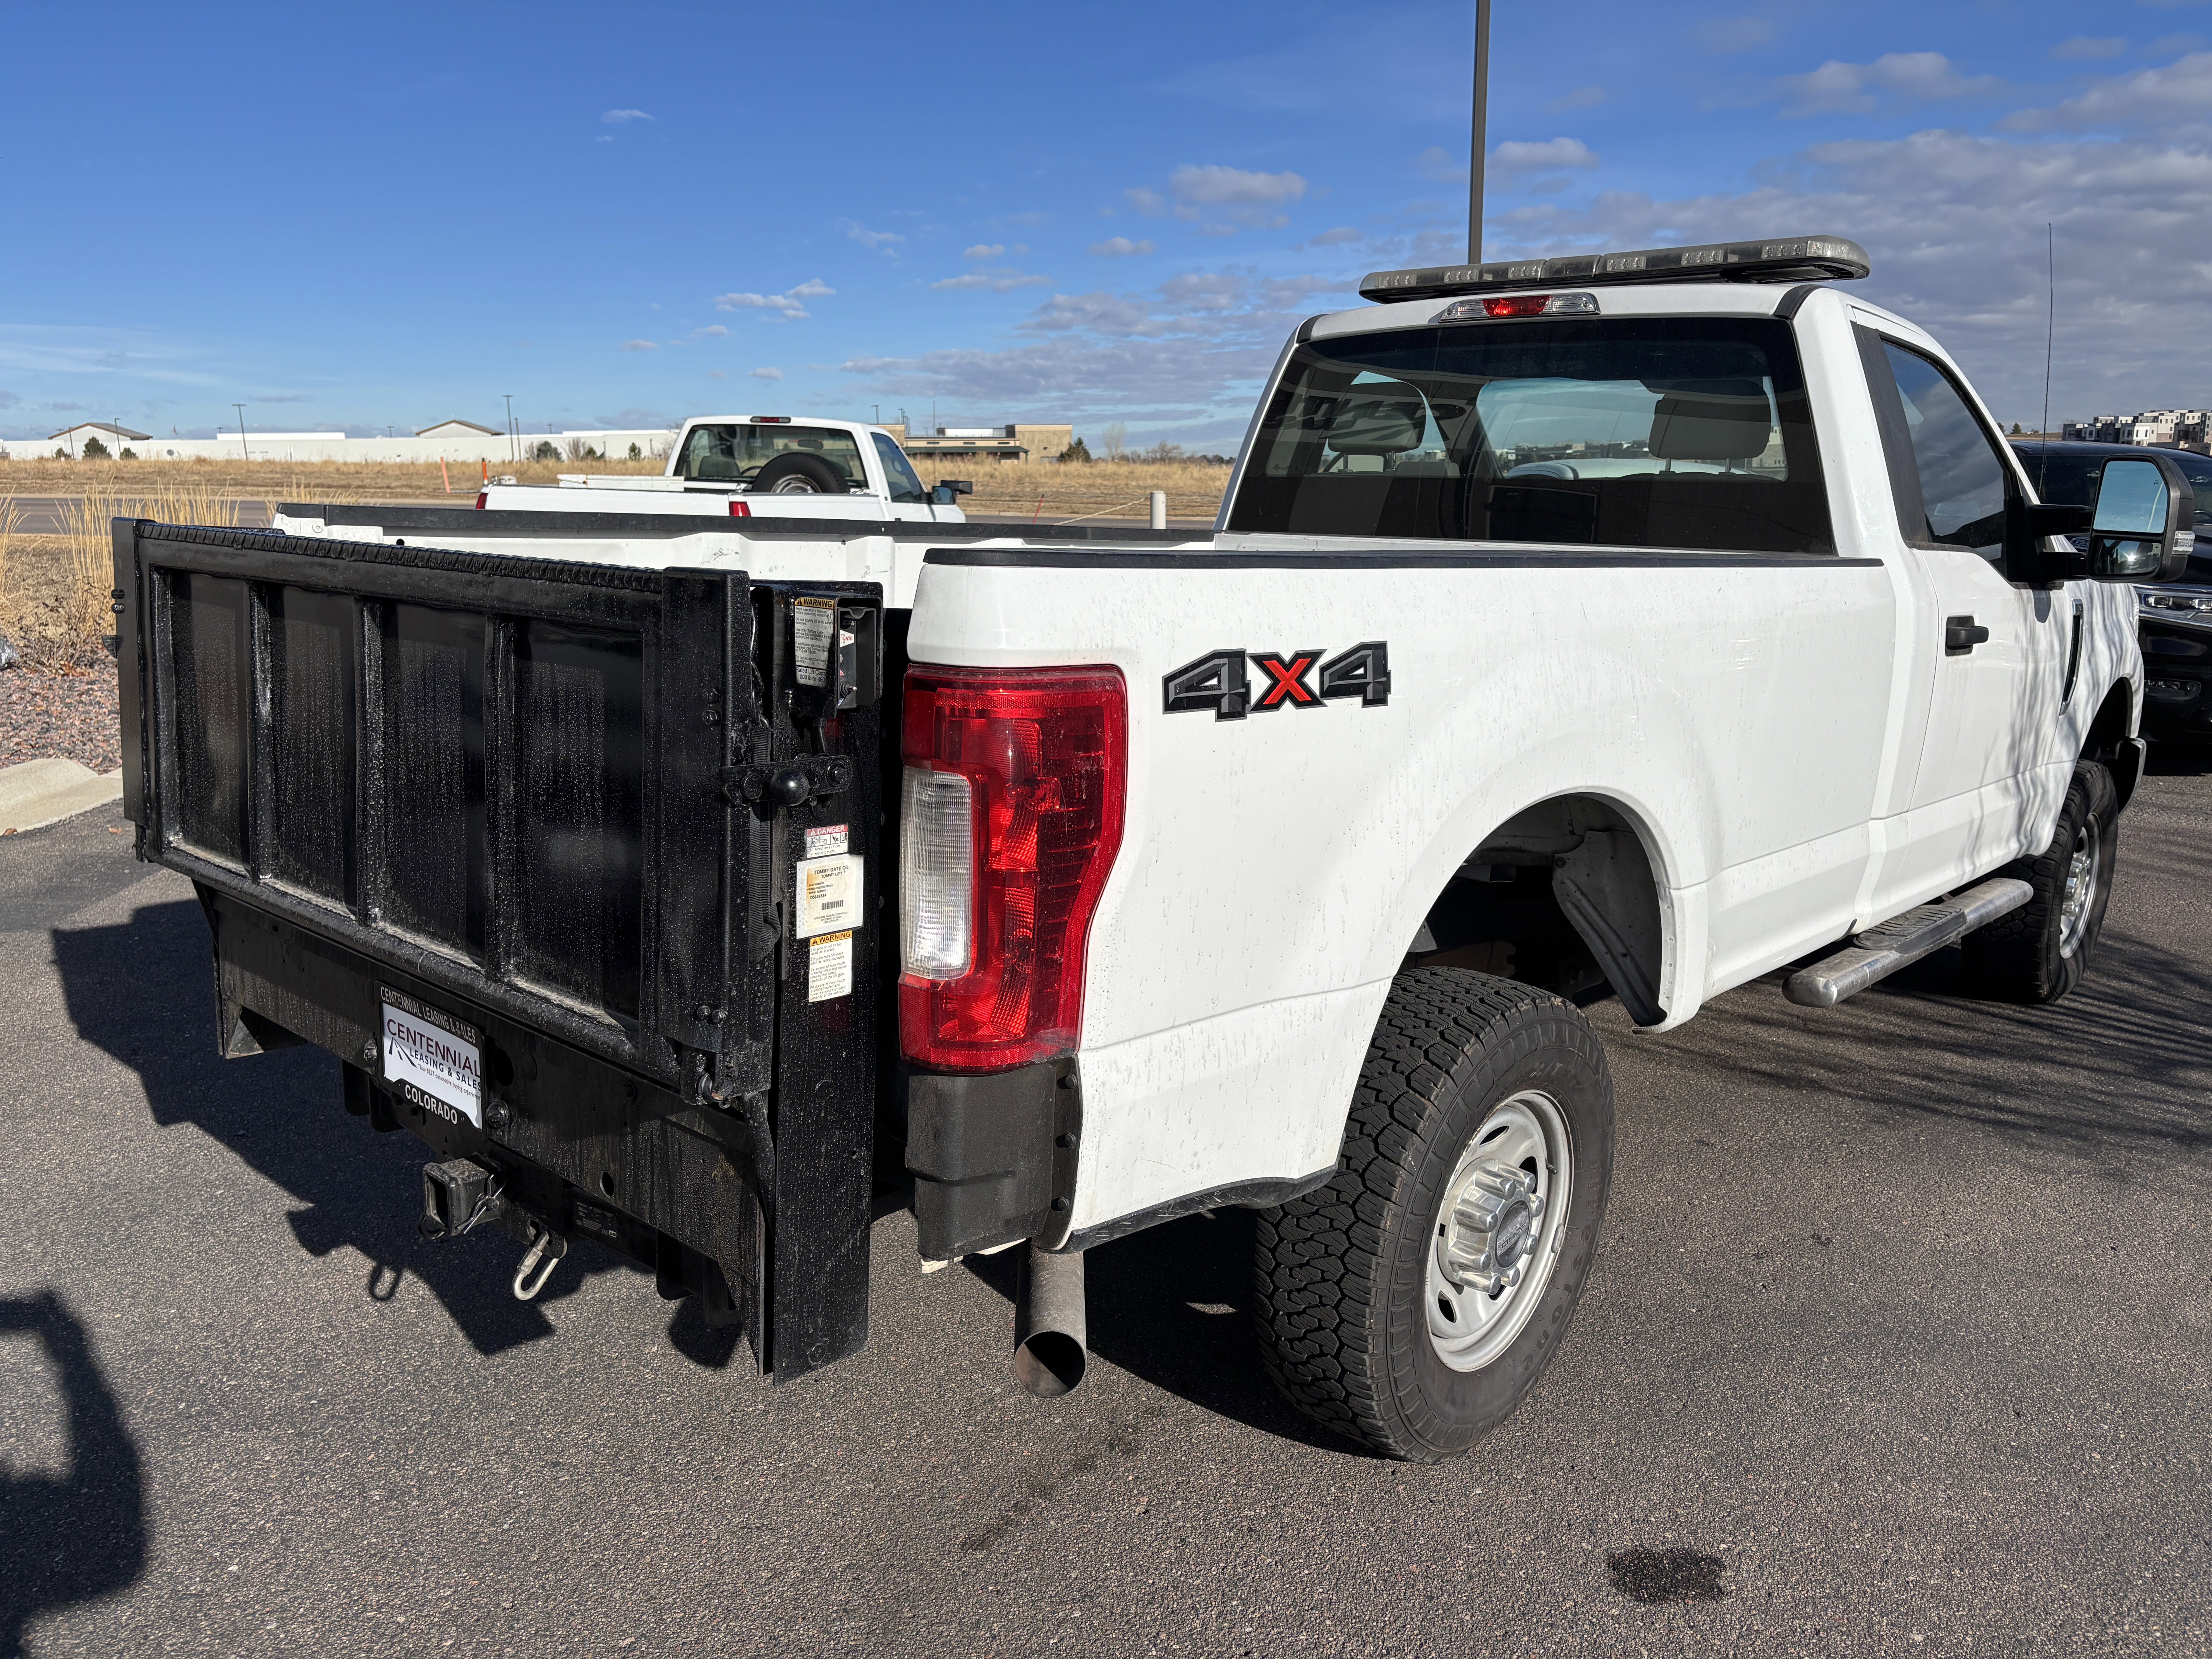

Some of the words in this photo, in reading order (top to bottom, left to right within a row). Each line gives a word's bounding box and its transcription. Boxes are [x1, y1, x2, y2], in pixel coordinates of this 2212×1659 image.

[804, 598, 832, 607] WARNING
[1162, 640, 1391, 723] 4X4
[817, 825, 845, 835] DANGER
[819, 932, 850, 943] WARNING
[380, 986, 422, 1017] CENTENNIAL
[422, 1005, 449, 1029] LEASING
[450, 1018, 455, 1032] &
[456, 1021, 476, 1044] SALES
[387, 1018, 481, 1078] CENTENNIAL
[410, 1047, 444, 1072] LEASING
[447, 1067, 453, 1077] &
[456, 1071, 481, 1091] SALES
[435, 1074, 452, 1086] automotive
[452, 1081, 462, 1093] buying
[405, 1084, 458, 1125] COLORADO
[1501, 1220, 1527, 1248] FORD
